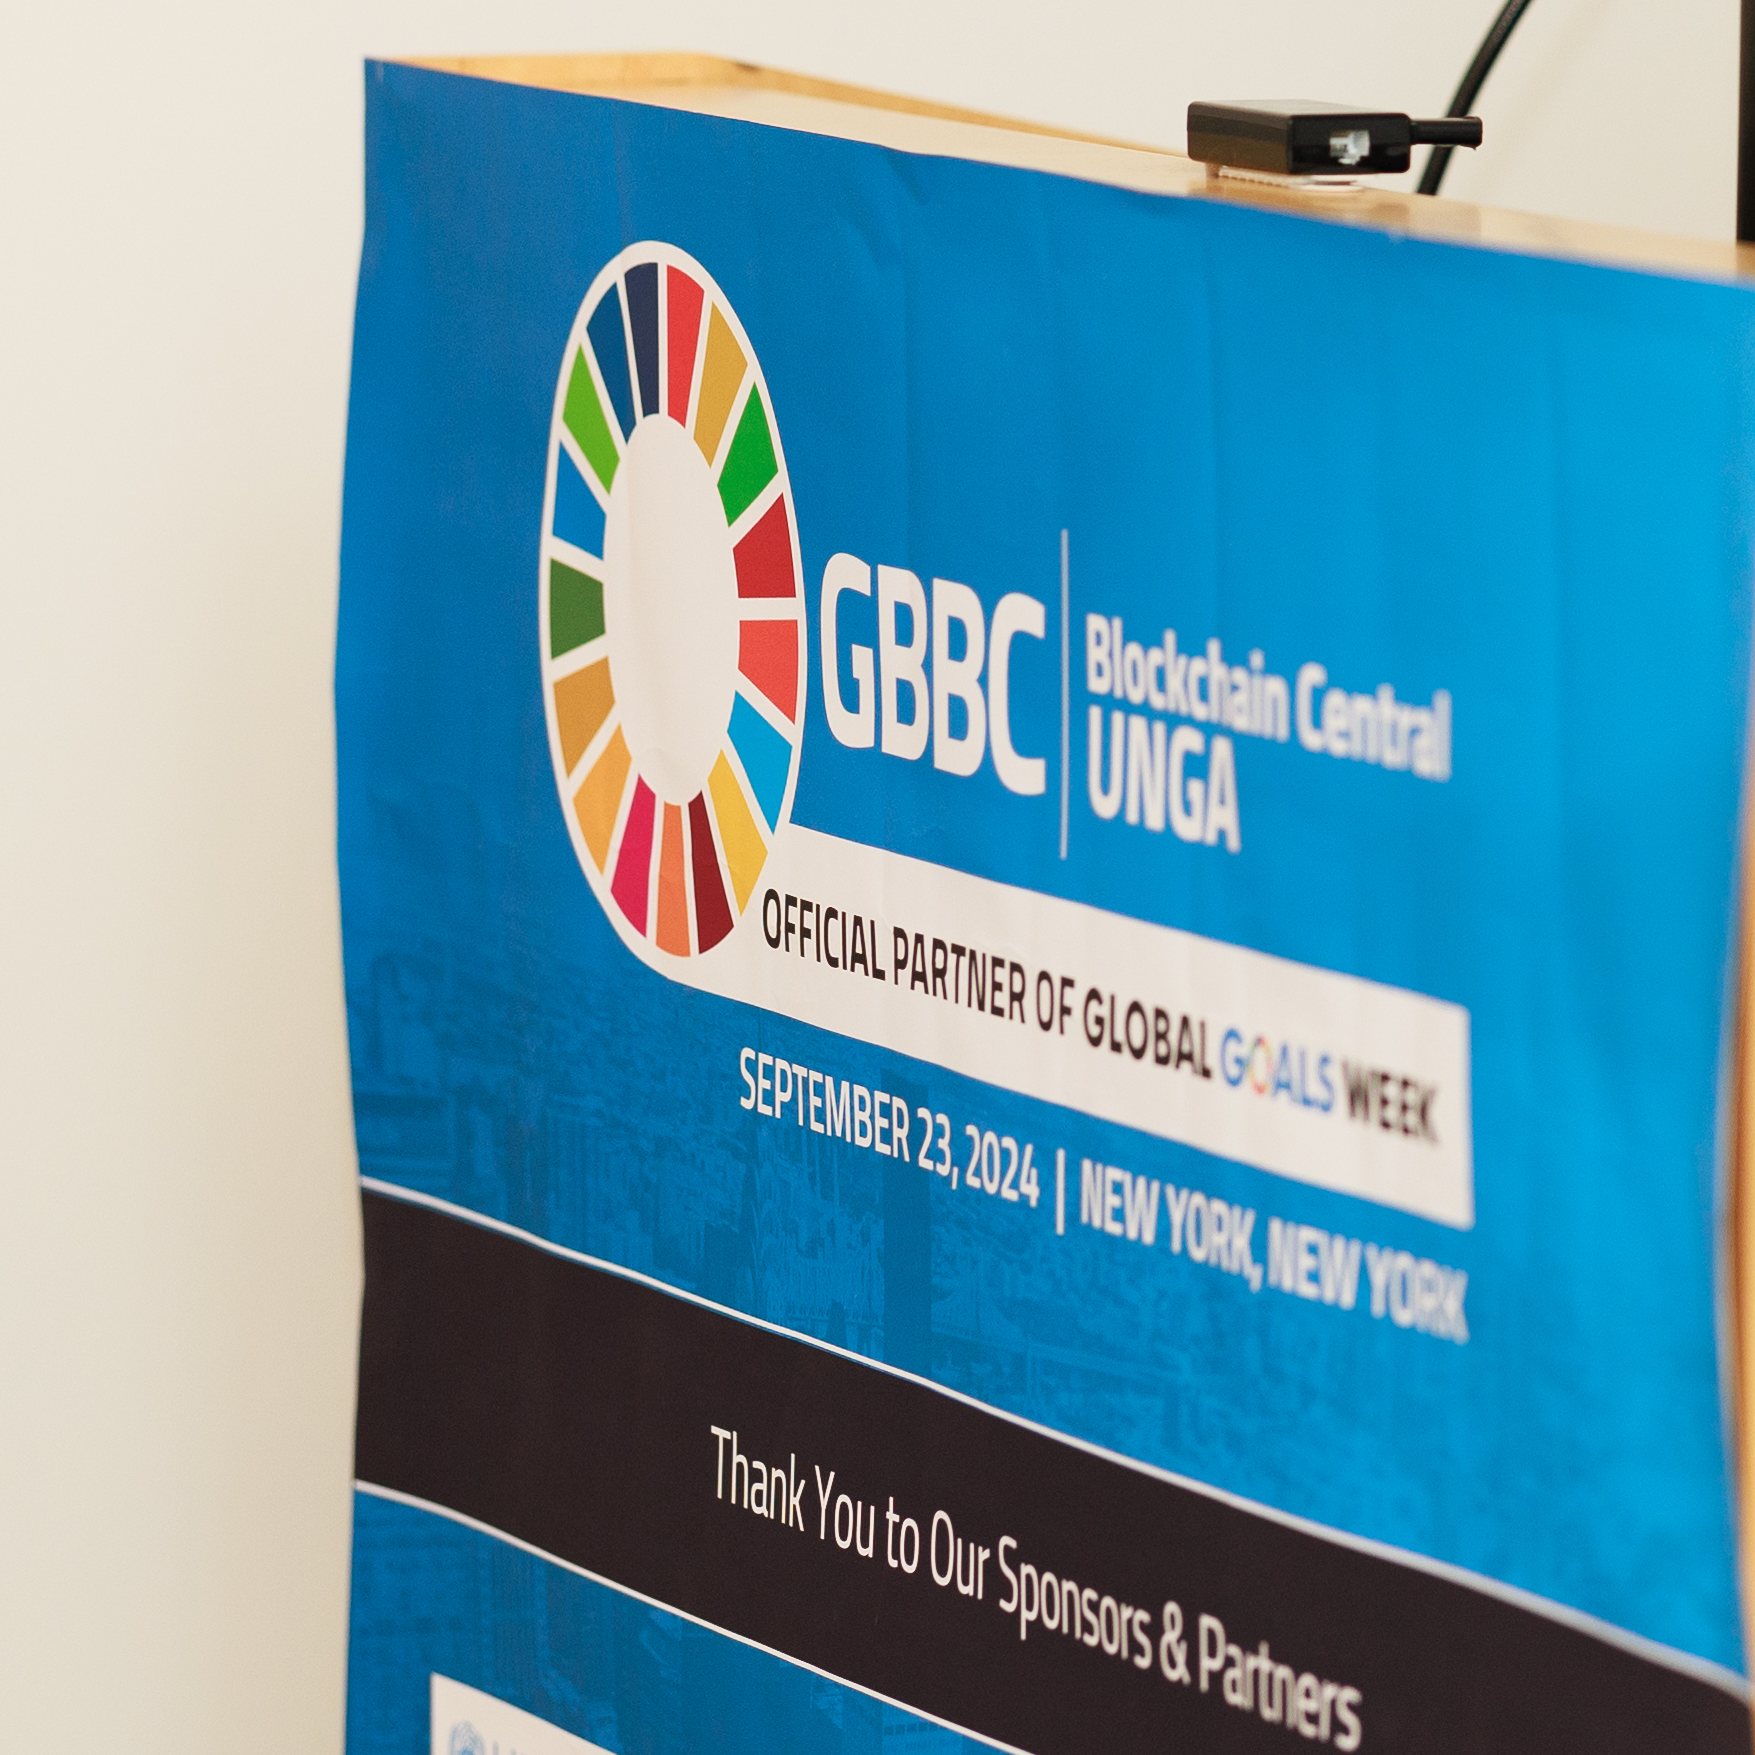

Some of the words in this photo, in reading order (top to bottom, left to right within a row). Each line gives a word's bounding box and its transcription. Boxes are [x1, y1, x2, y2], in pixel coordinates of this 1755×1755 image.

[820, 552, 1046, 795] GBBC
[1085, 612, 1289, 743] Blockchain
[1295, 661, 1453, 783] Central
[1087, 704, 1242, 854] UNGA
[762, 888, 886, 981] OFFICIAL
[893, 926, 1026, 1024] PARTNER
[1036, 970, 1075, 1035] OF
[1083, 987, 1212, 1079] GLOBAL
[1219, 1027, 1335, 1113] GOALS
[1342, 1058, 1439, 1148] WEEK
[740, 1047, 910, 1162] SEPTEMBER
[965, 1125, 1040, 1208] 2024
[1080, 1158, 1160, 1246] NEW
[1165, 1183, 1263, 1294] YORK,
[1267, 1216, 1362, 1311] NEW
[1364, 1241, 1470, 1345] YORK
[711, 1425, 805, 1531] Thank
[815, 1465, 875, 1558] You
[886, 1496, 919, 1573] to
[931, 1510, 990, 1599] Our
[999, 1536, 1152, 1669] Sponsors
[1160, 1600, 1191, 1685] &
[1199, 1612, 1363, 1752] Partners
